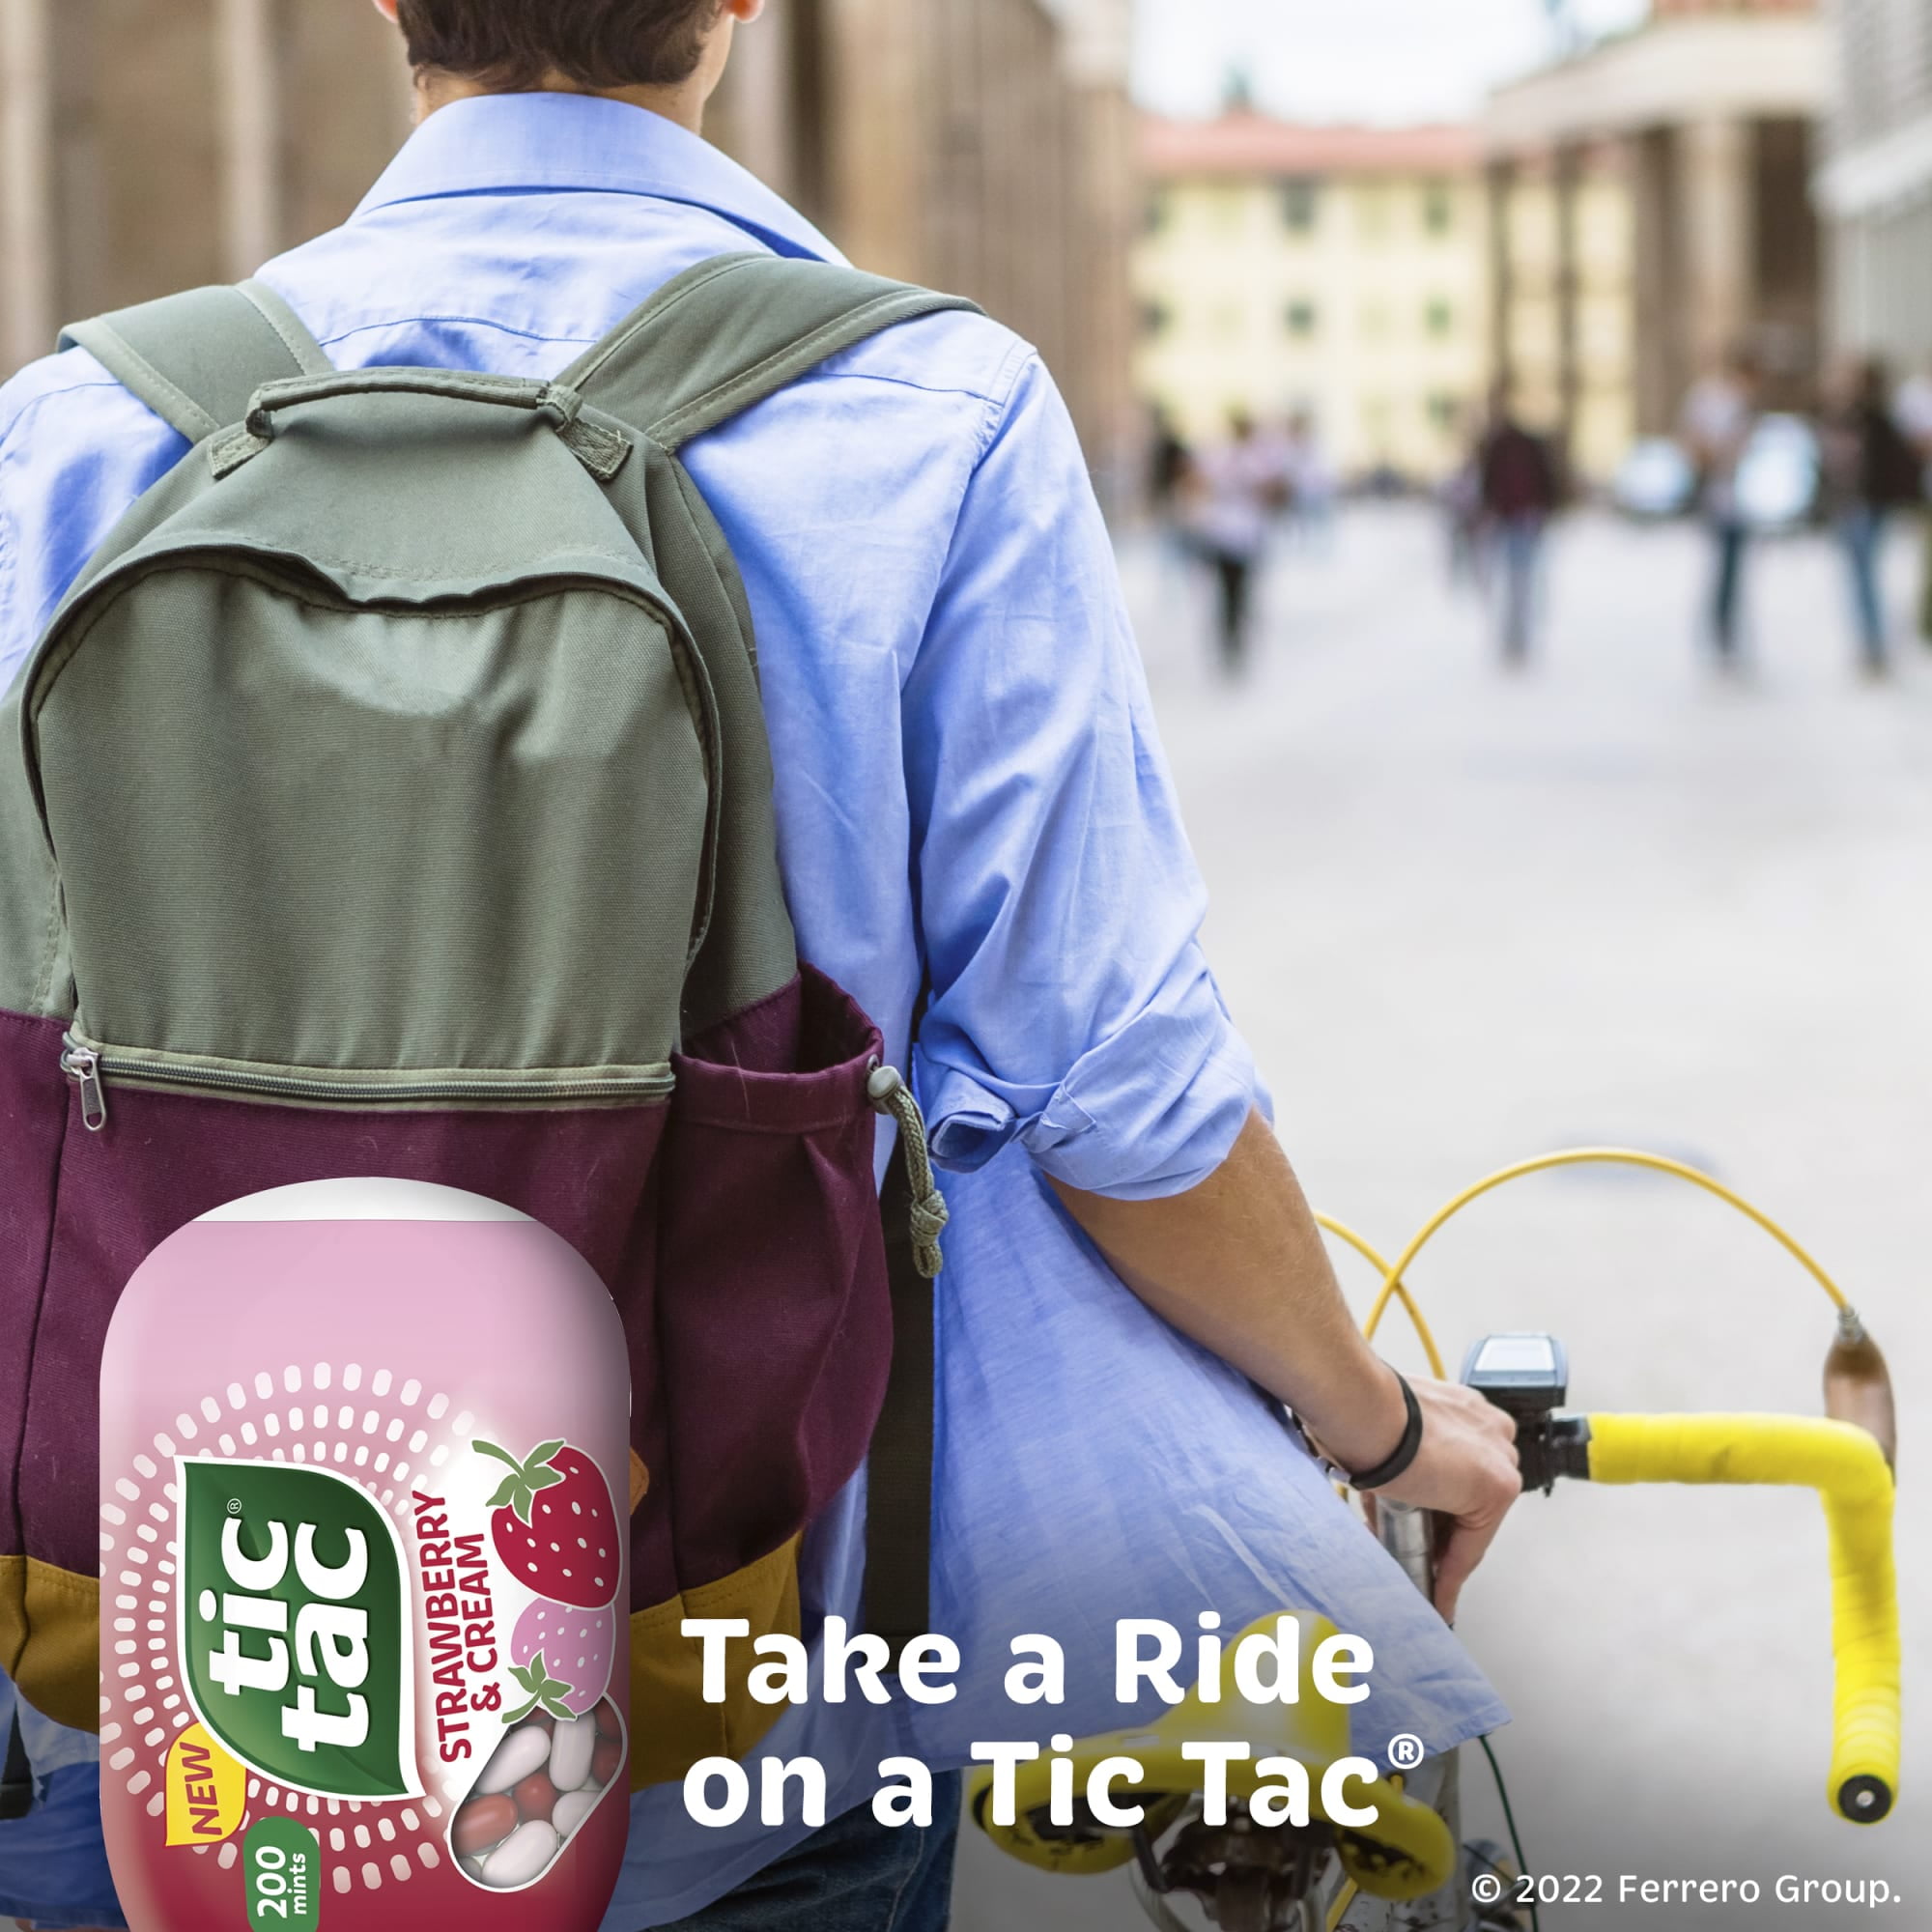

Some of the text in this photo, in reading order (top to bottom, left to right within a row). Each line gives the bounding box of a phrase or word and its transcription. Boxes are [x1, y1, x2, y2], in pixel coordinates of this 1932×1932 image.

[280, 1521, 370, 1753] tac
[411, 1489, 473, 1764] STRAWBERRY
[453, 1532, 502, 1713] & CREAM
[178, 1741, 224, 1836] NEW
[254, 1845, 288, 1918] 200
[287, 1852, 307, 1916] mints
